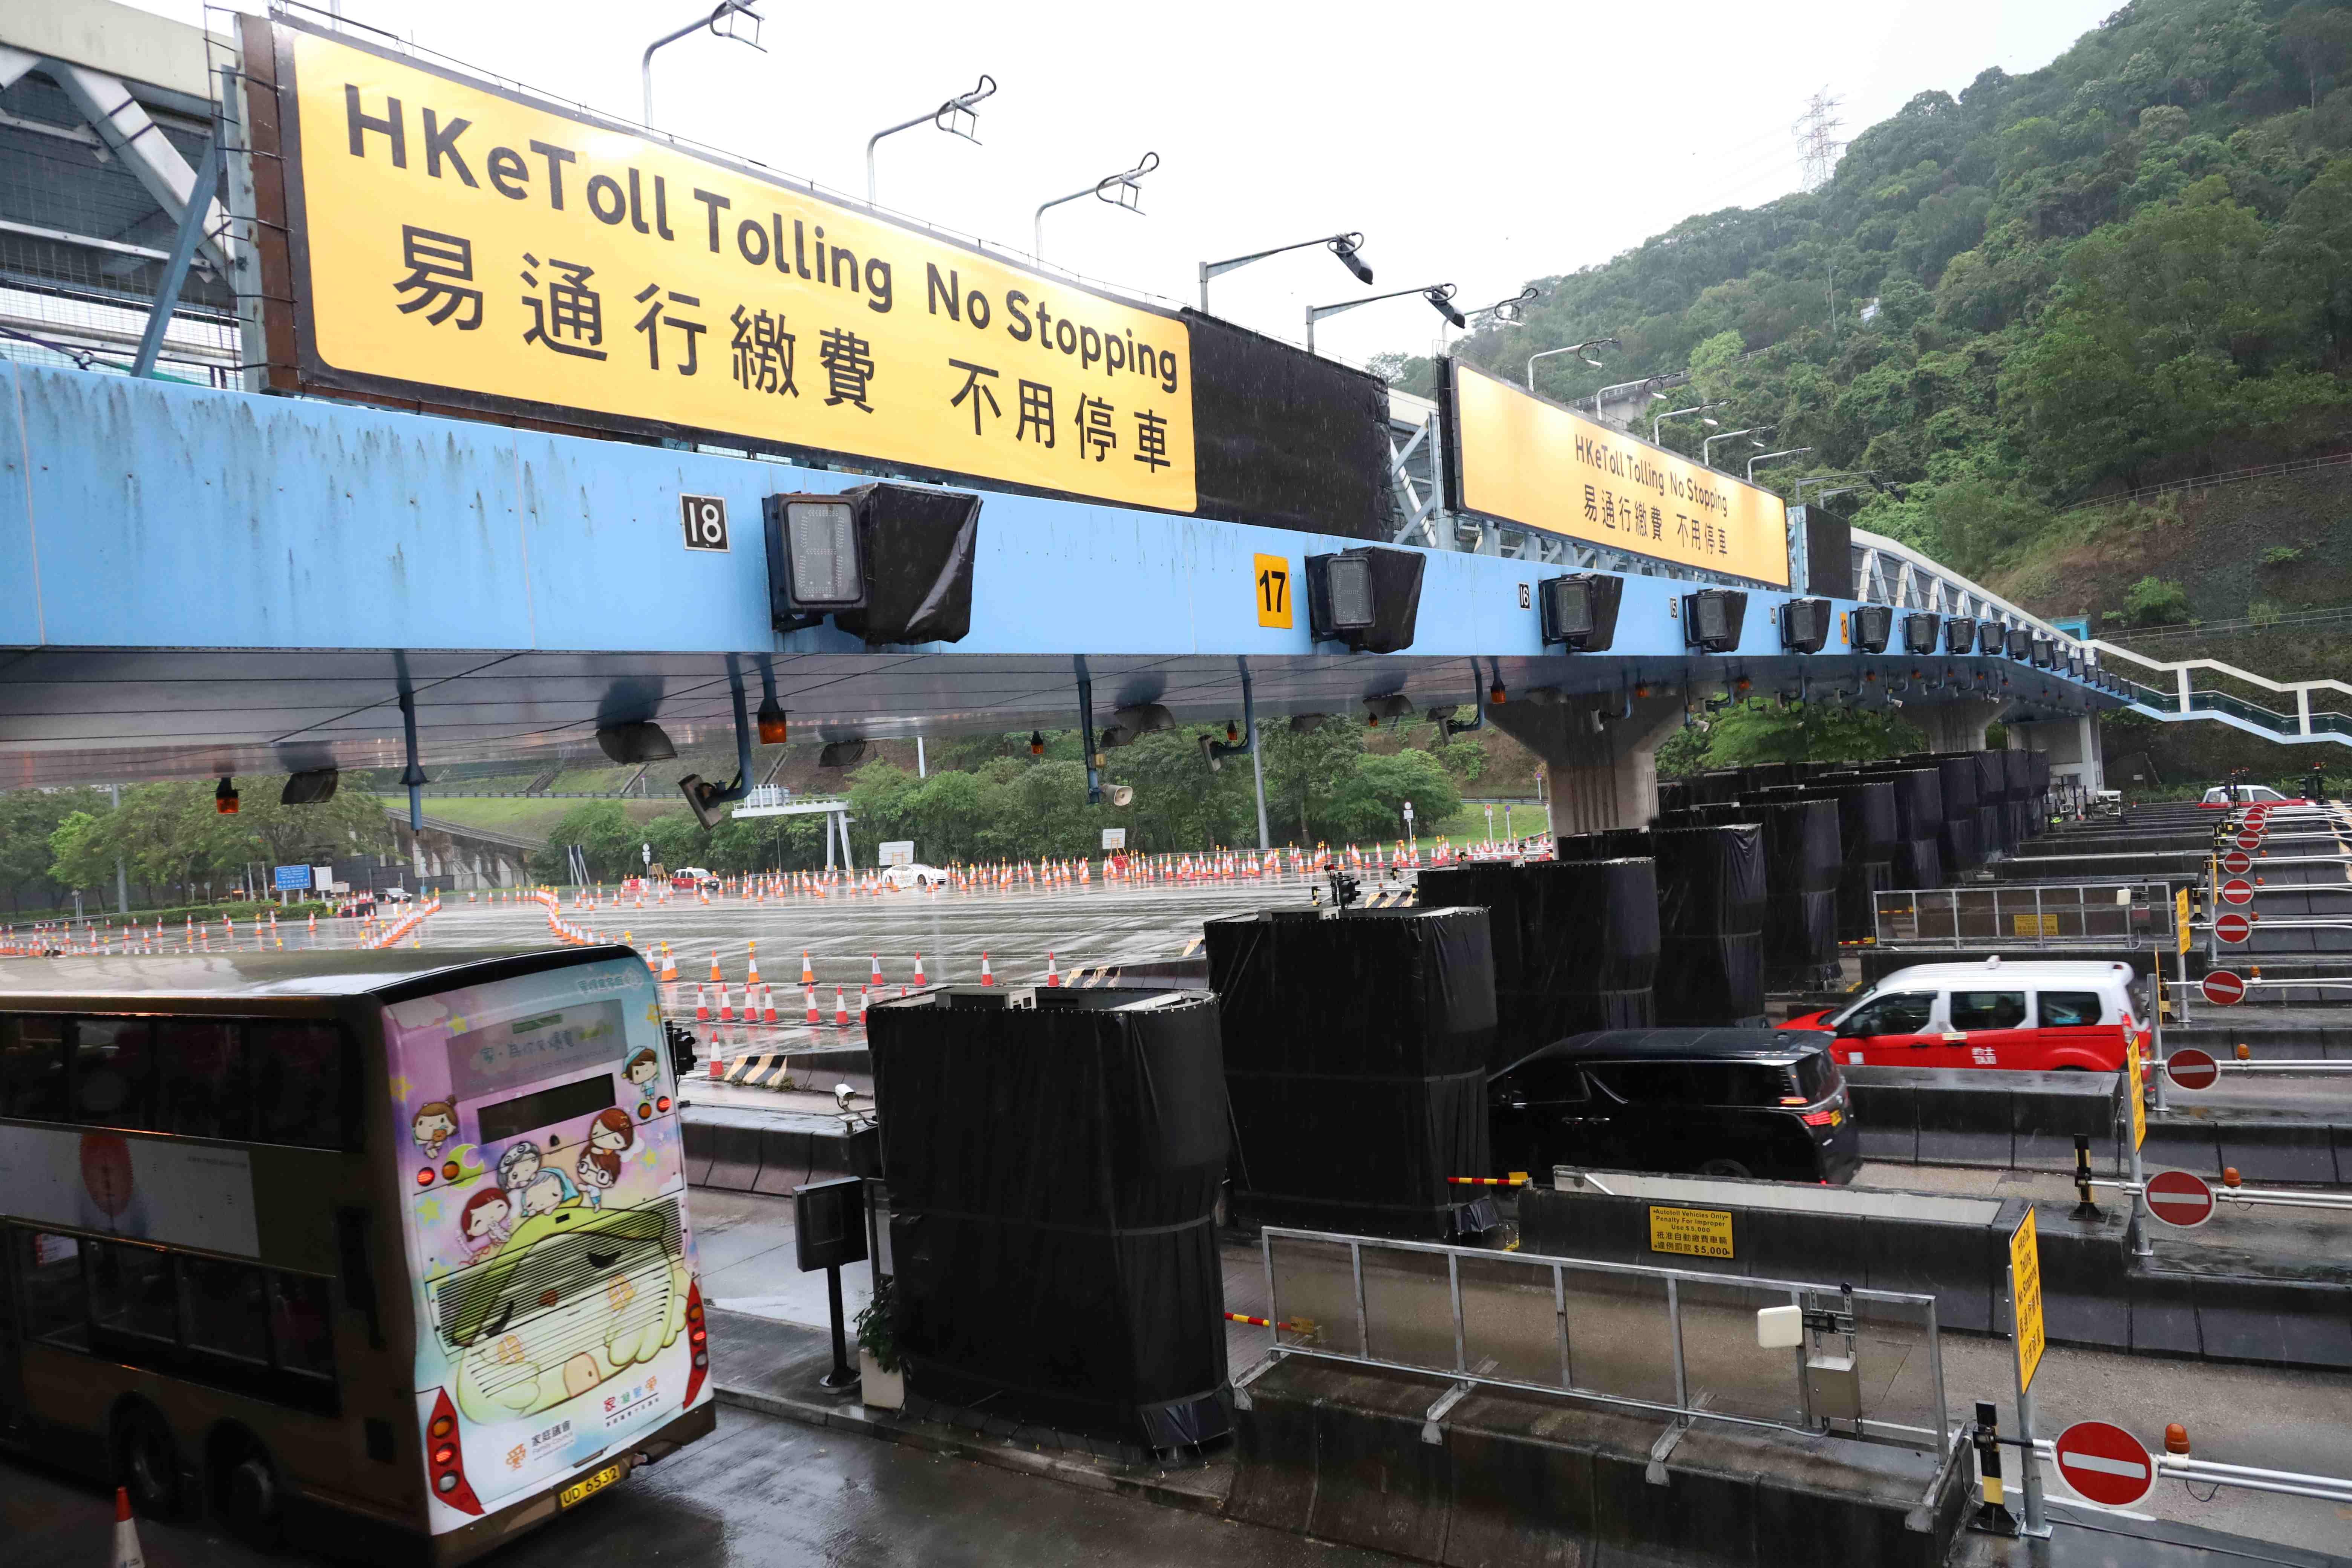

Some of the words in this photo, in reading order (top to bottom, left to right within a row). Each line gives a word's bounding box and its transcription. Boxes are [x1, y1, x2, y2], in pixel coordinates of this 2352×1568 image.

[345, 83, 674, 241] HKeToll
[694, 187, 892, 313] Tolling
[927, 262, 990, 329] No
[1007, 290, 1177, 393] Stopping
[392, 224, 874, 414] 易通行繳費
[948, 358, 1170, 473] 不用停車
[1576, 434, 1624, 477] HKeToll
[1627, 454, 1664, 496] Tolling
[1671, 471, 1684, 498] No
[1687, 478, 1727, 517] Stopping
[689, 502, 722, 543] 18
[1584, 484, 1663, 542] 易通行繳費
[1677, 514, 1727, 558] 不用停車
[1259, 570, 1286, 612] 17
[1520, 586, 1529, 606] 16
[1671, 600, 1677, 616] 15
[1841, 619, 1847, 638] 13
[1972, 1056, 1997, 1064] TAXI
[1695, 1219, 1725, 1228] Improper
[1657, 1242, 1692, 1252] 違例罰款
[1694, 1245, 1727, 1256] $5,000
[562, 1487, 581, 1504] UD
[585, 1467, 617, 1492] 6532
